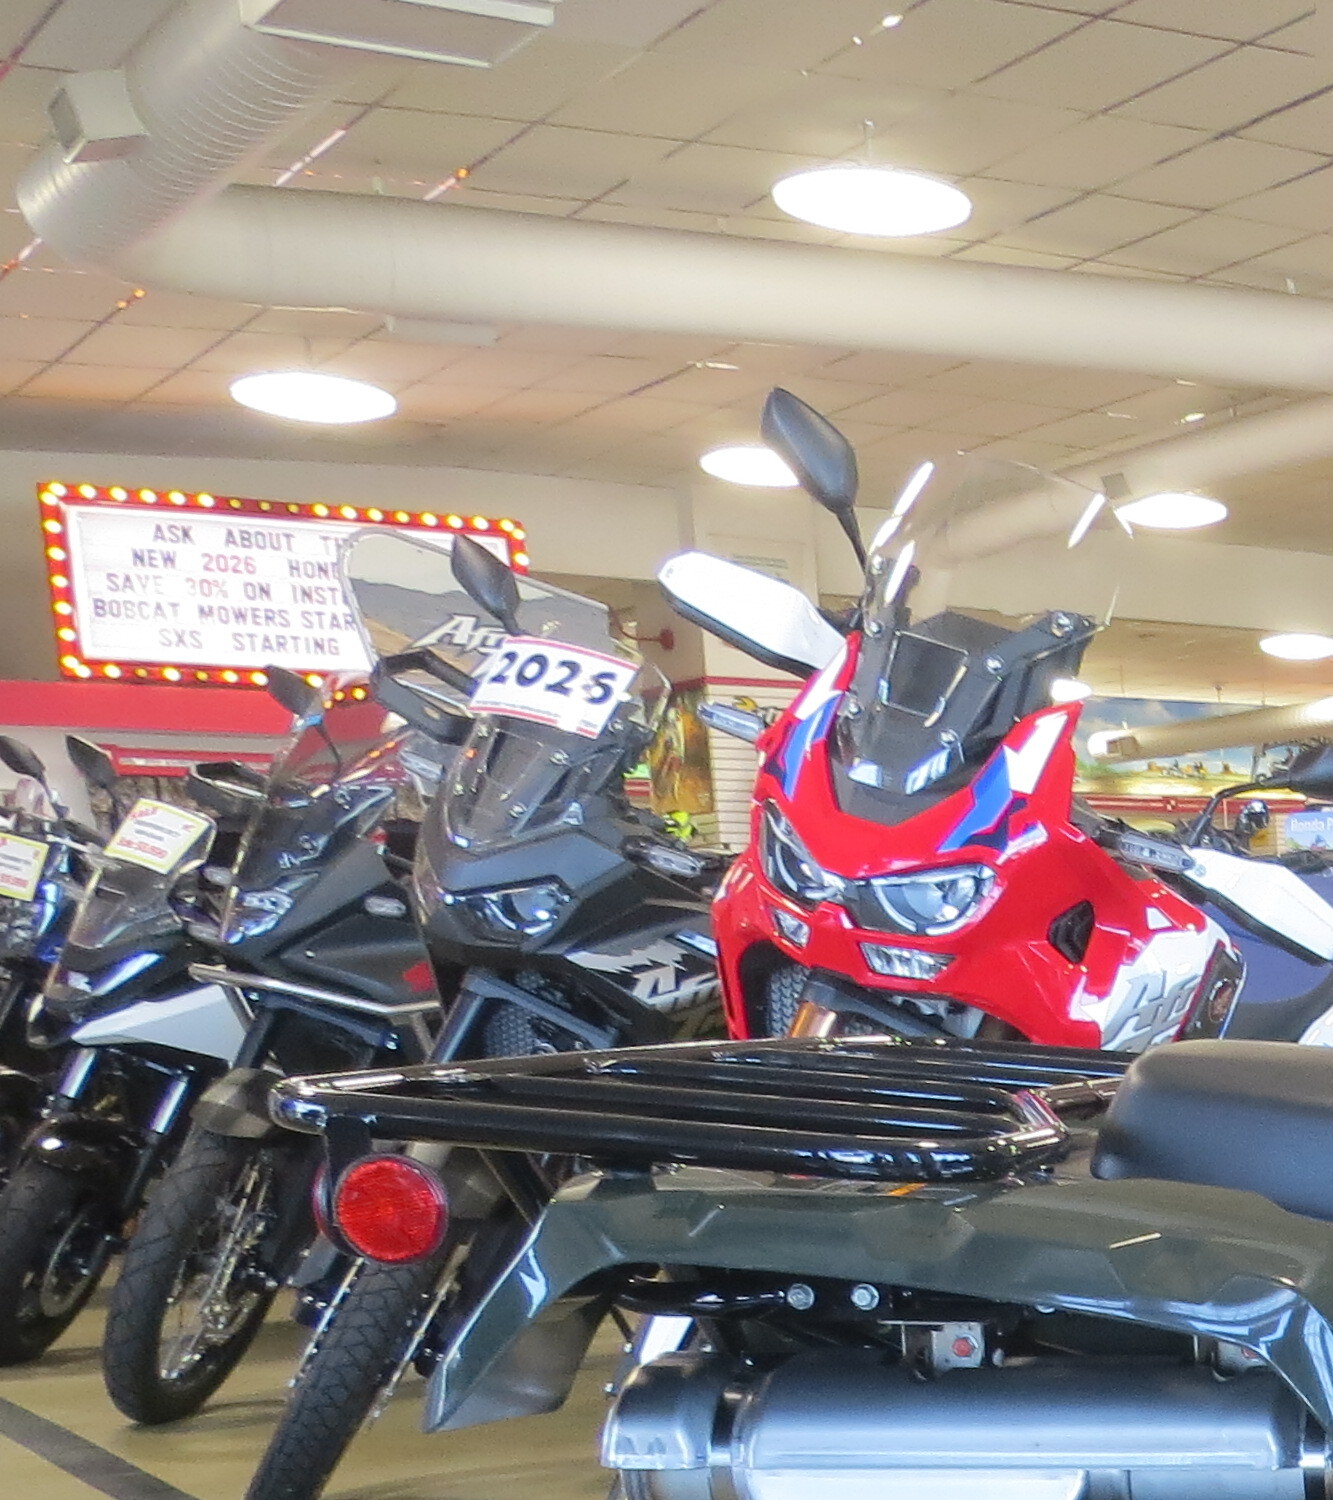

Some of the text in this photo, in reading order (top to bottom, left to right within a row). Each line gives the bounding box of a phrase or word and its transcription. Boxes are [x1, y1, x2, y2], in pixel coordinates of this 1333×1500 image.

[152, 523, 354, 556] ASK ABOUT TH
[131, 549, 177, 569] NEW
[201, 553, 257, 575] 2026
[106, 573, 164, 596] SAVE
[185, 577, 228, 599] 30%
[243, 582, 272, 601] ON
[93, 597, 357, 632] BOBCAT MOWERS STAR
[159, 628, 341, 656] SXS STARTING
[1290, 818, 1324, 831] Honda
